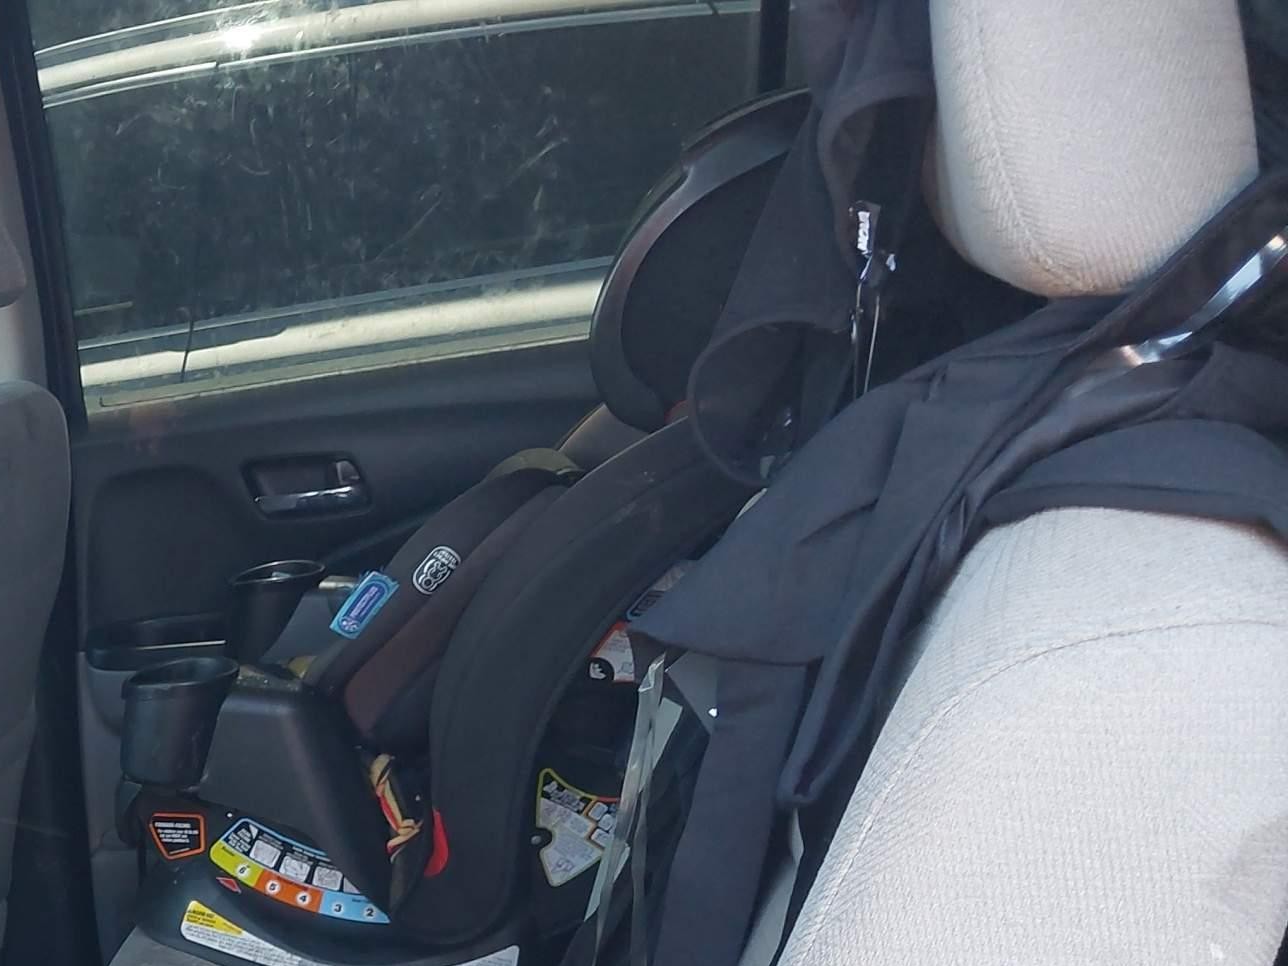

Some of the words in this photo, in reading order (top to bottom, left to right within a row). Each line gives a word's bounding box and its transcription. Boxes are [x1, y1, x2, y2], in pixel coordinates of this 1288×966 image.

[299, 894, 308, 903] 4
[333, 903, 343, 913] 3
[365, 907, 375, 918] 2
